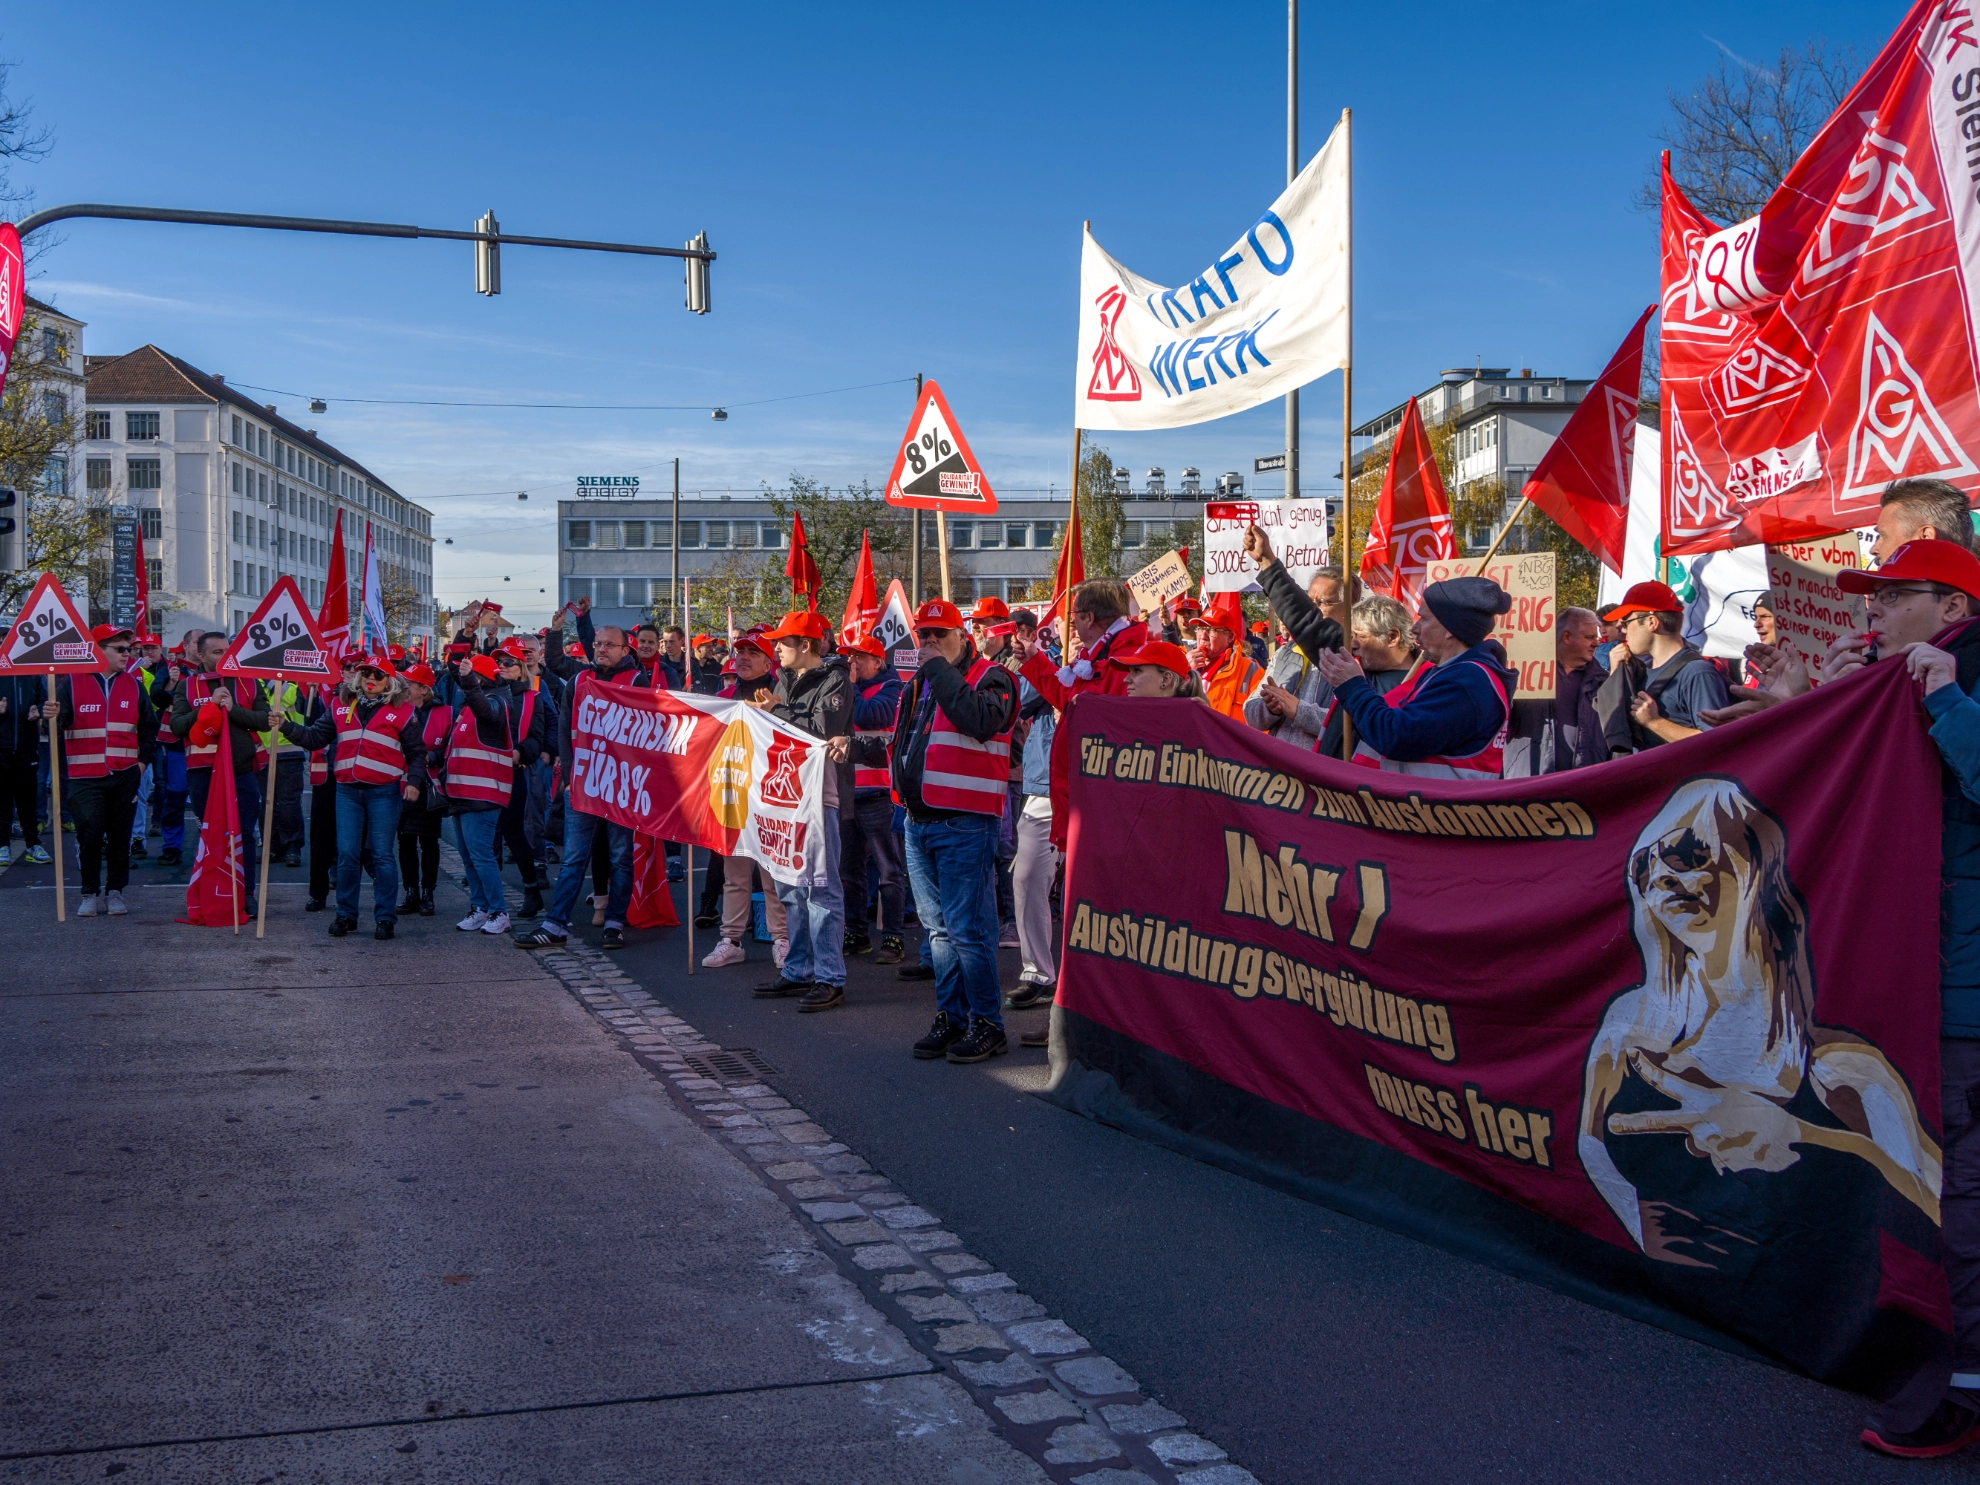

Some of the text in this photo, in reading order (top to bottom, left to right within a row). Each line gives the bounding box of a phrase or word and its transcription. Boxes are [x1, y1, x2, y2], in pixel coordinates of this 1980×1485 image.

[1149, 308, 1282, 398] WERK
[906, 427, 952, 474] 8%
[577, 476, 640, 486] SIEMENS
[1131, 564, 1159, 590] AZUBIS
[1140, 563, 1179, 593] ZUSAMMEN
[1206, 550, 1250, 575] 3000€
[1163, 573, 1189, 598] KAMPF
[1775, 590, 1790, 613] ist
[18, 608, 67, 647] 8%
[249, 612, 301, 650] 8%
[1776, 615, 1810, 635] seiner
[285, 649, 320, 657] SOLIDARITÄT
[79, 704, 101, 712] GEBT
[120, 700, 129, 708] 8!
[577, 695, 698, 756] GEMEINSAM
[573, 739, 651, 816] FÜR 8%
[1081, 736, 1595, 837] Für ein Einkommen zum Auskommen
[1224, 829, 1340, 943] Mehr
[1068, 902, 1457, 1063] Ausbildungsvergütung
[1365, 1062, 1553, 1167] muss her
